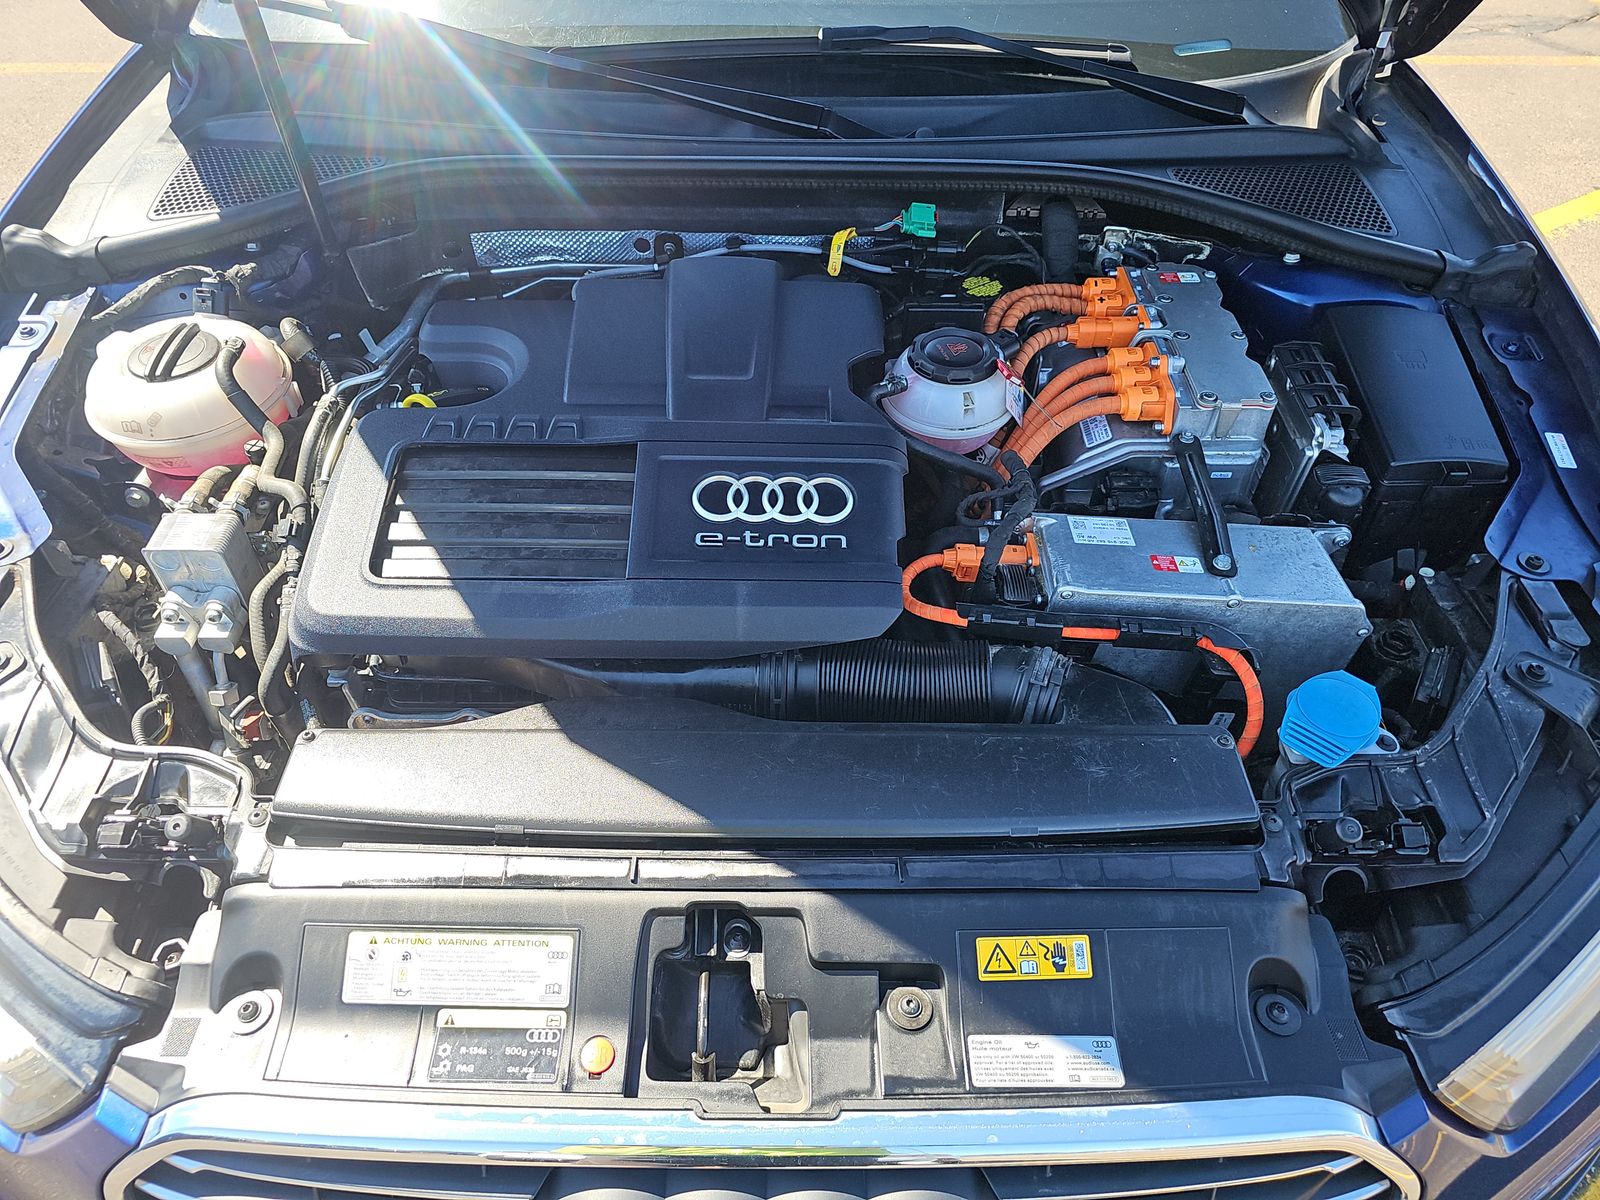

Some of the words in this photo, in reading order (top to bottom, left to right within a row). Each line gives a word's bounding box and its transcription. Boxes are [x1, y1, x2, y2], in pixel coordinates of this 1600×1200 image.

[695, 530, 848, 549] e-tron
[383, 937, 432, 945] ACHTUNG
[438, 938, 488, 946] WARNING
[493, 939, 550, 948] ATTENTION
[459, 1046, 487, 1055] R-134a
[505, 1047, 527, 1057] 500g
